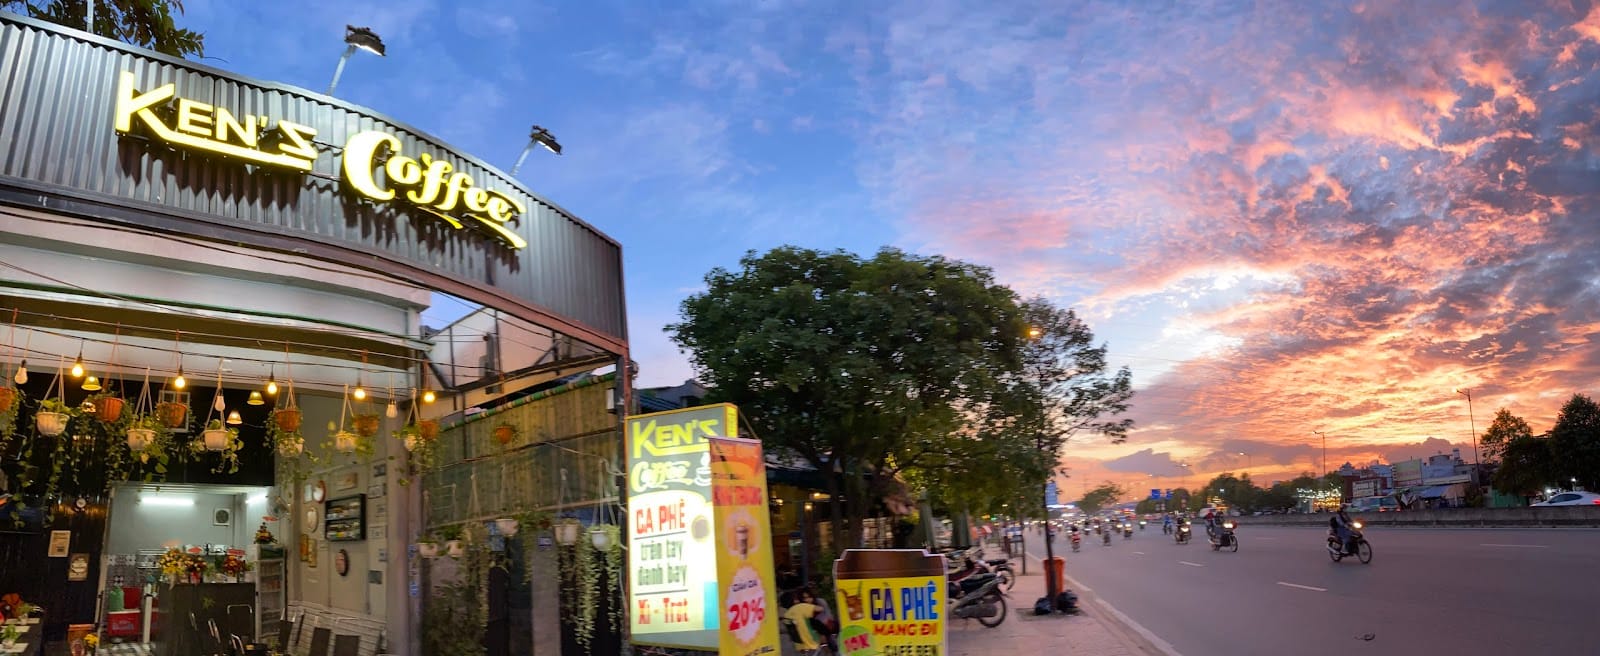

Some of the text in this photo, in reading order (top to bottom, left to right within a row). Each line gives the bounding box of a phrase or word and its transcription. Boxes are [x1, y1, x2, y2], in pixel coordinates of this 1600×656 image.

[115, 70, 528, 248] KEN'S Coffee
[632, 419, 719, 458] KEN'S
[630, 461, 694, 493] Coffee
[728, 597, 765, 631] 20%
[870, 580, 938, 620] CÀ PHÊ
[873, 623, 917, 636] MANG
